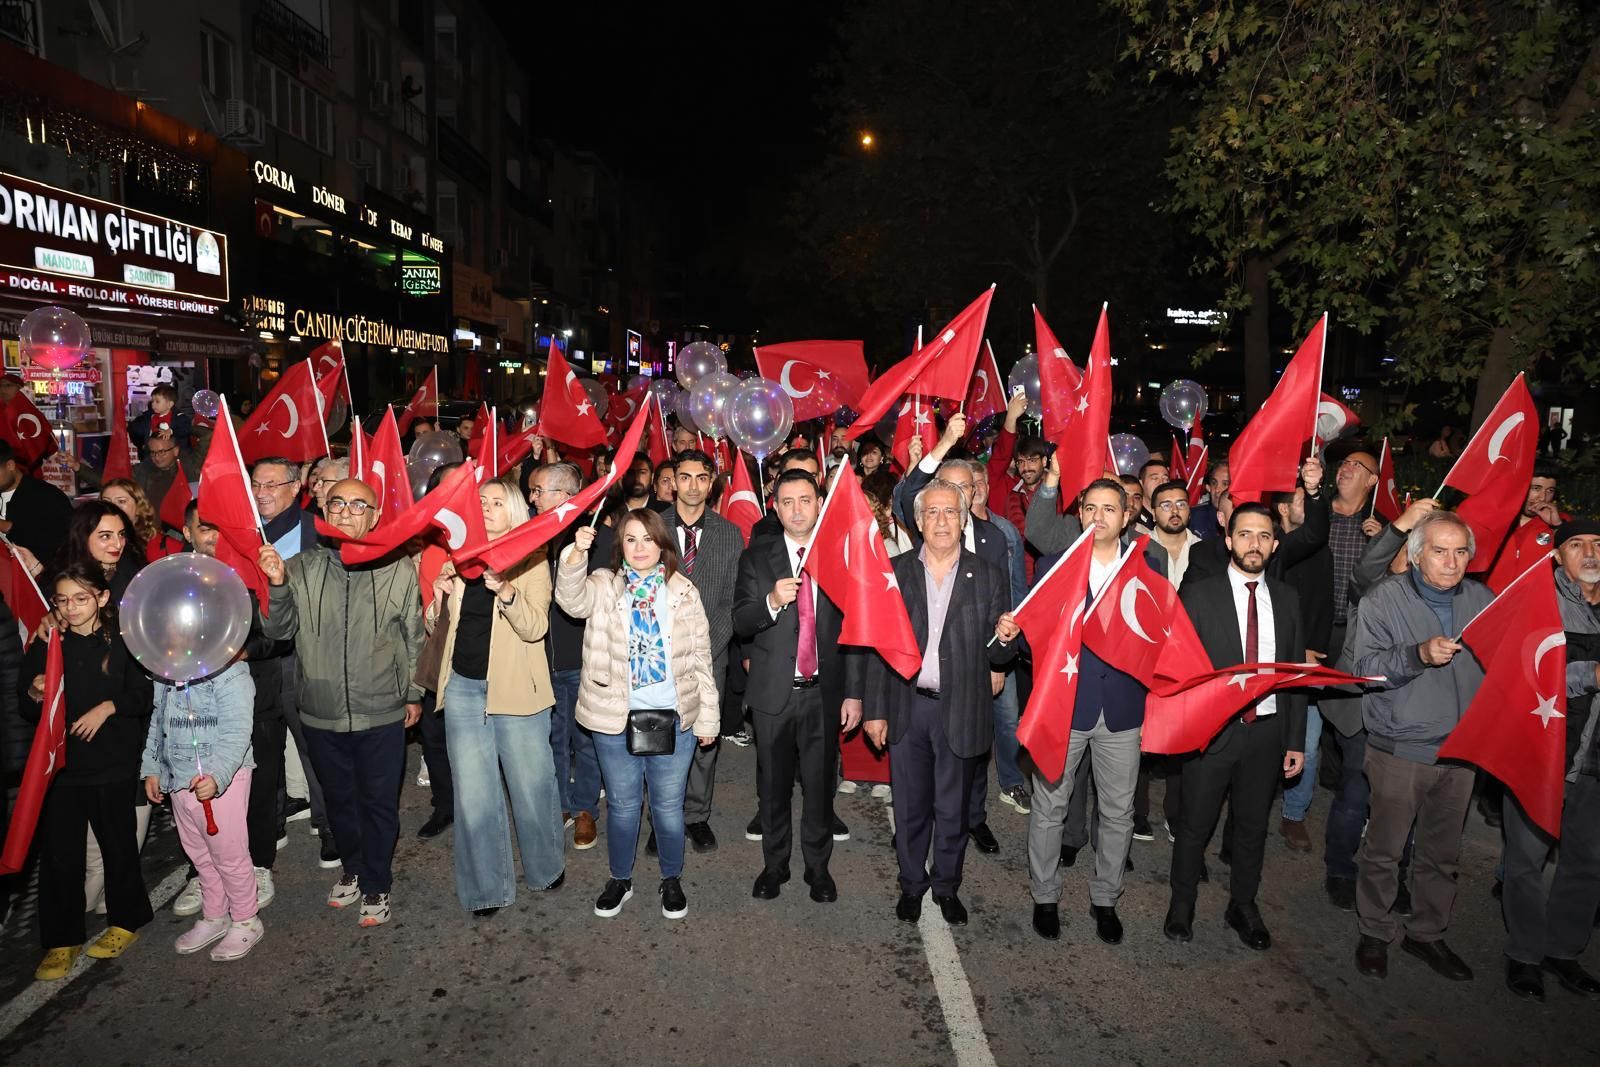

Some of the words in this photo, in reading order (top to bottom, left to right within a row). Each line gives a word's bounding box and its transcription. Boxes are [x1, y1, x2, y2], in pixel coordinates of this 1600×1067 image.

[254, 161, 296, 194] ÇORBA
[312, 186, 347, 215] DÖNER
[391, 218, 412, 240] KEBAP
[104, 208, 193, 265] ÇİFTLİĞİ
[42, 252, 89, 274] MANDIRA
[129, 268, 171, 287] ŞARKÜTERİ
[9, 274, 58, 294] DOĞAL
[136, 293, 178, 310] YÖRESEL
[294, 309, 344, 341] CANIM
[396, 327, 431, 351] MEHMET
[432, 335, 449, 353] USTA
